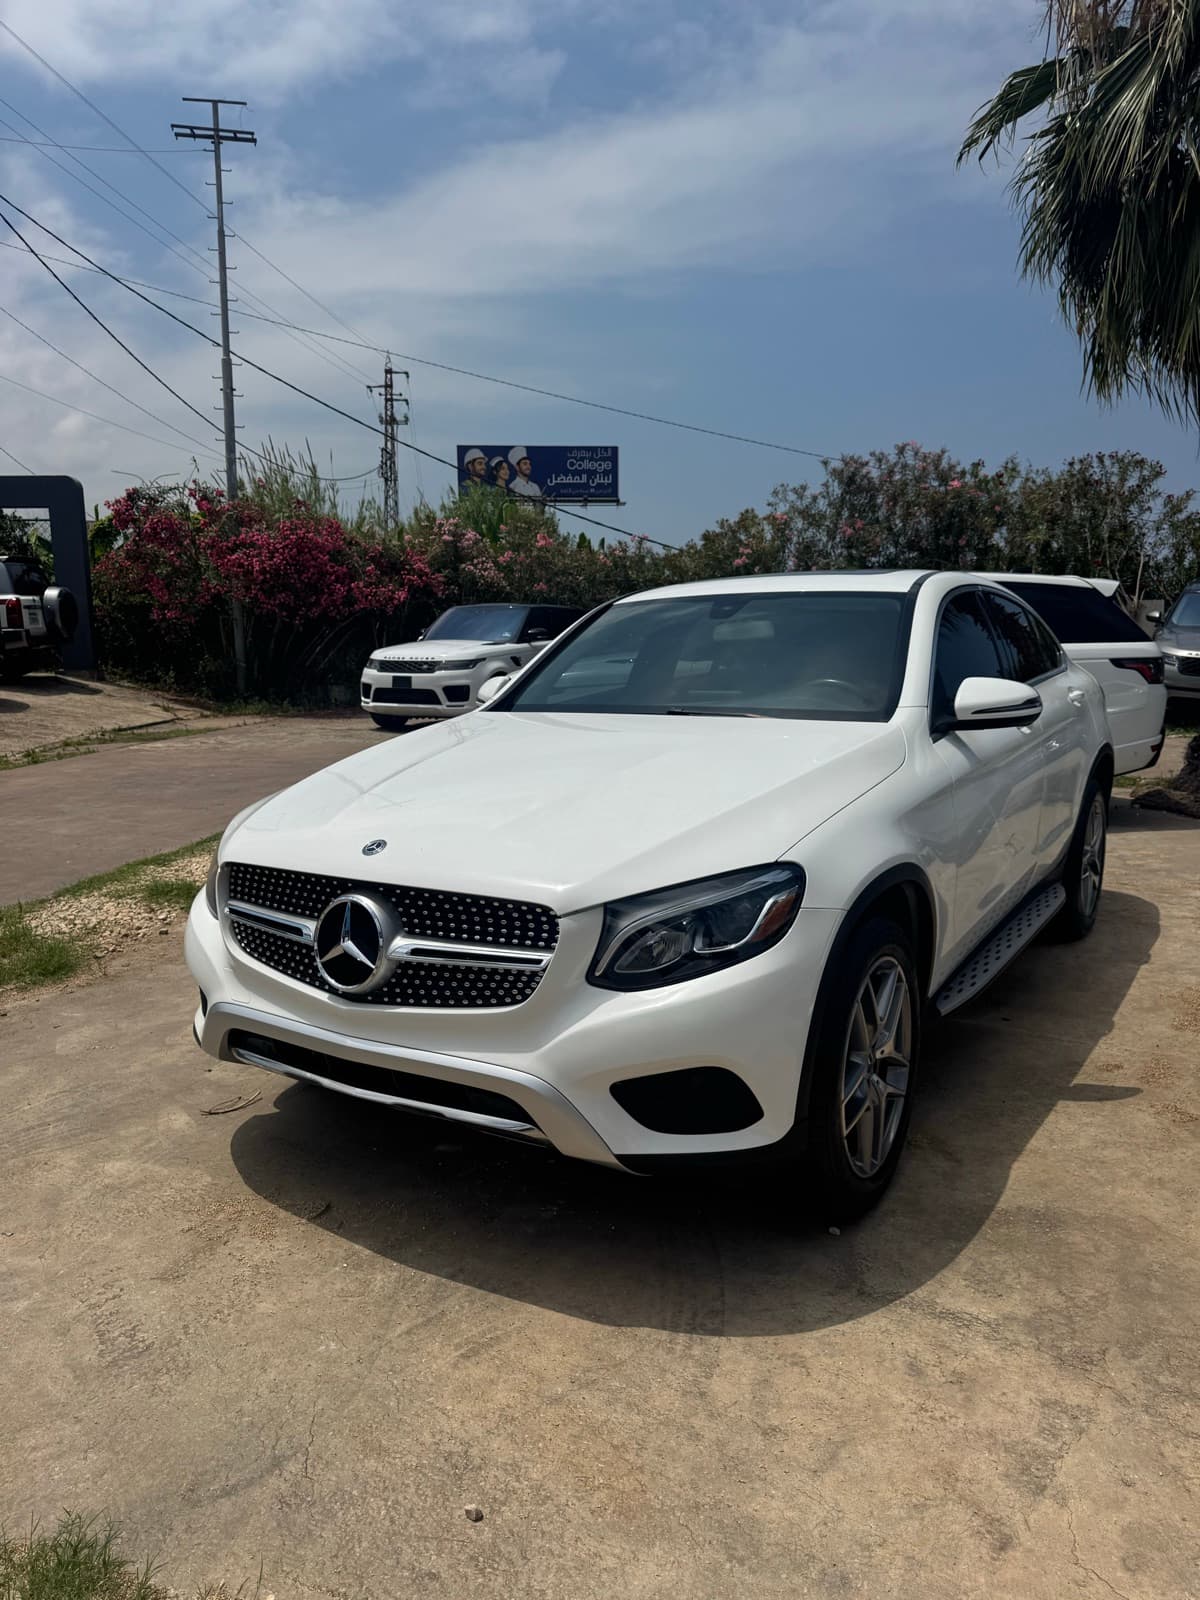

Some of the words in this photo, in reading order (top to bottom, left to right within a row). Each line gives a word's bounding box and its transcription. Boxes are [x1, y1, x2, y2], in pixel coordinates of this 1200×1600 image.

[566, 459, 612, 472] College
[547, 473, 587, 486] المفضل
[589, 473, 612, 487] لبنان
